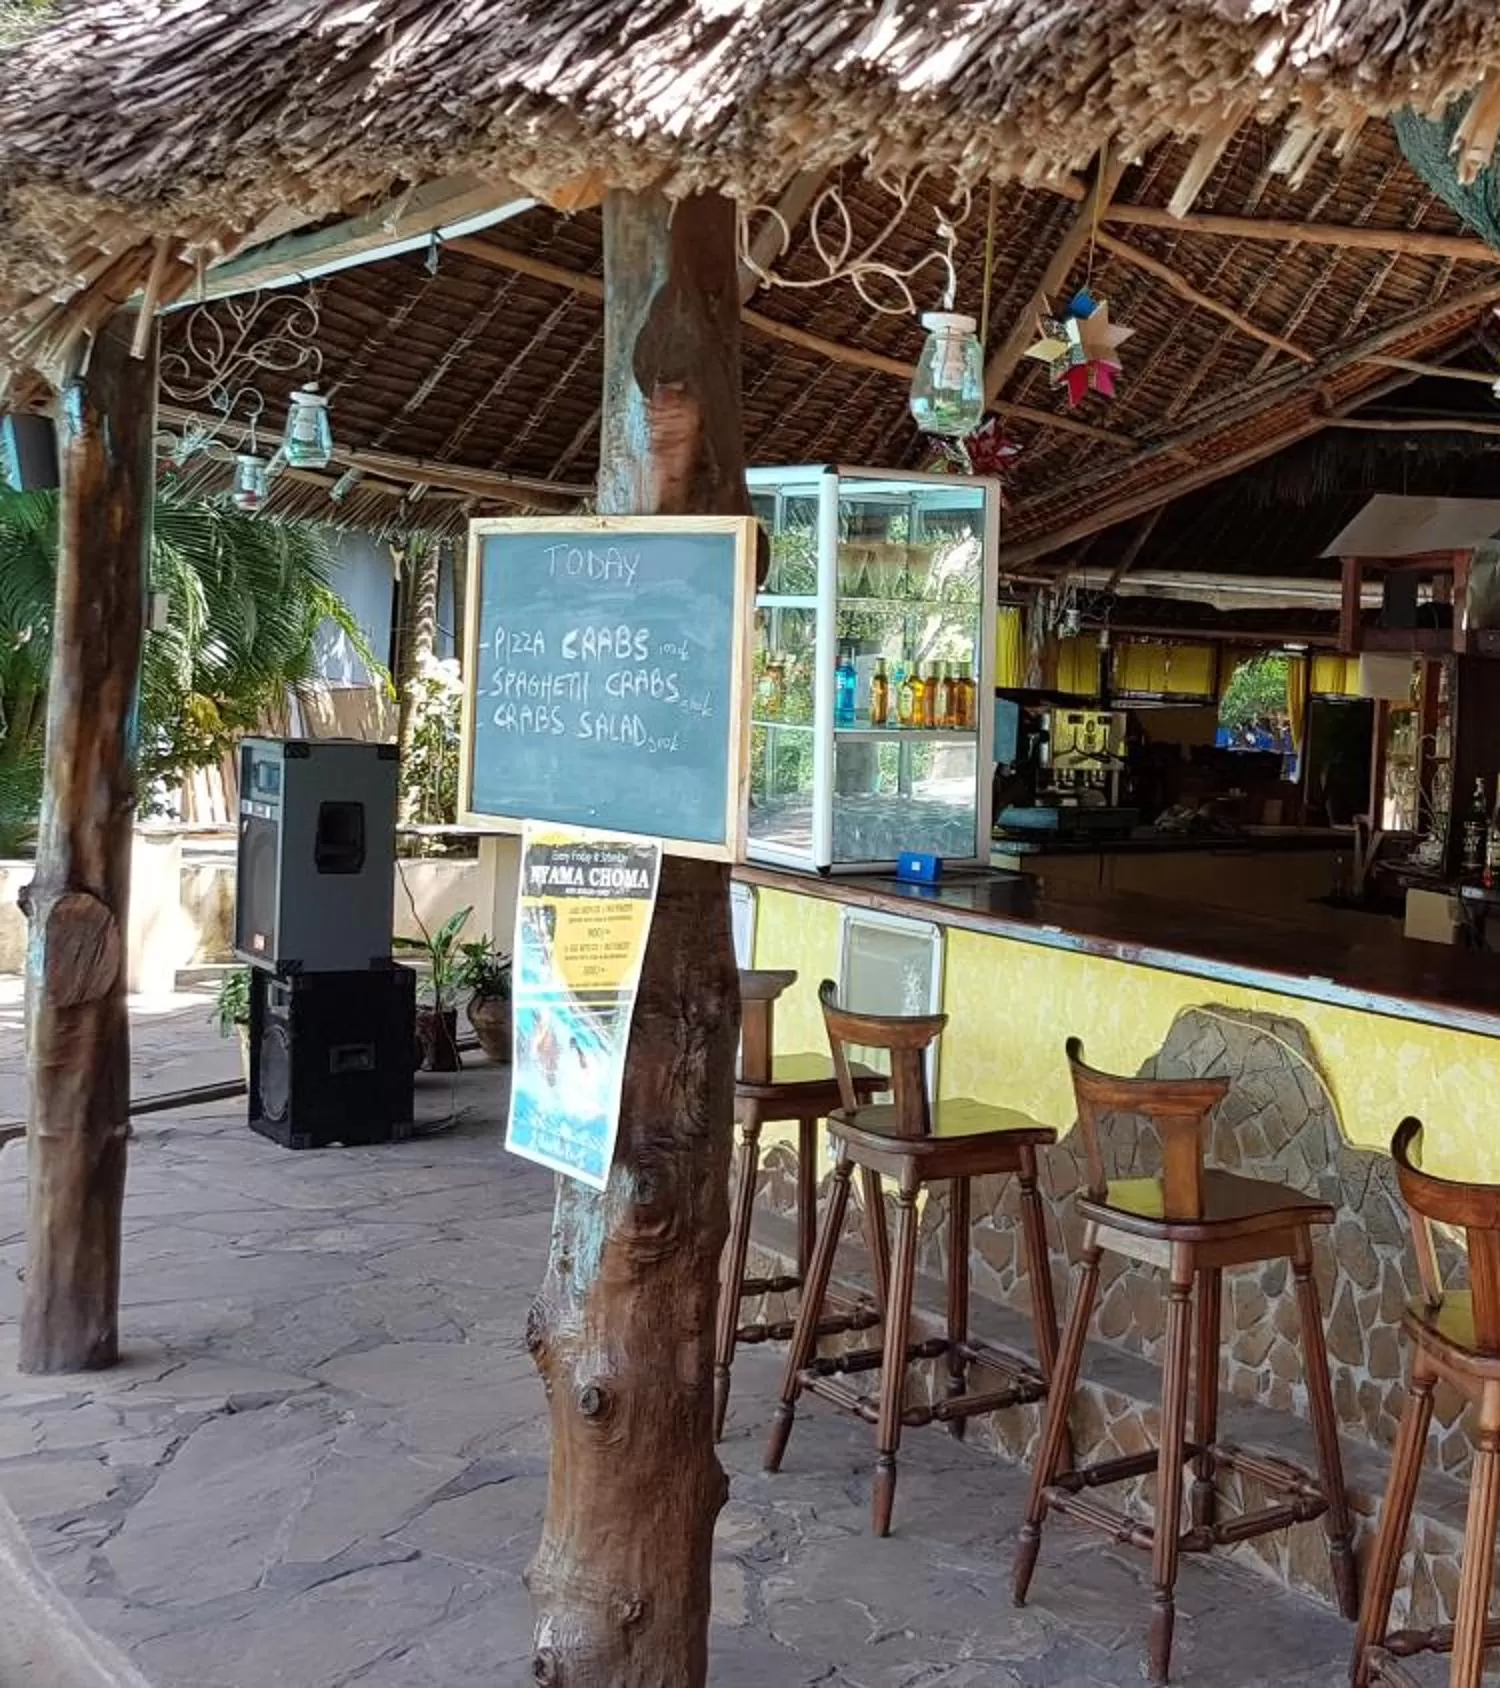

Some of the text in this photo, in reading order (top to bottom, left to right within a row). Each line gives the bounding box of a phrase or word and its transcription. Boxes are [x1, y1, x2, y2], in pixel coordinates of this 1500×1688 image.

[544, 543, 641, 586] TODAY
[495, 627, 545, 662] PIZZA
[561, 625, 650, 661] CRABS
[605, 667, 681, 704] CRABS
[493, 705, 565, 738] CRABS
[579, 711, 648, 749] SALAD
[530, 865, 650, 889] NYAMA CHOMA
